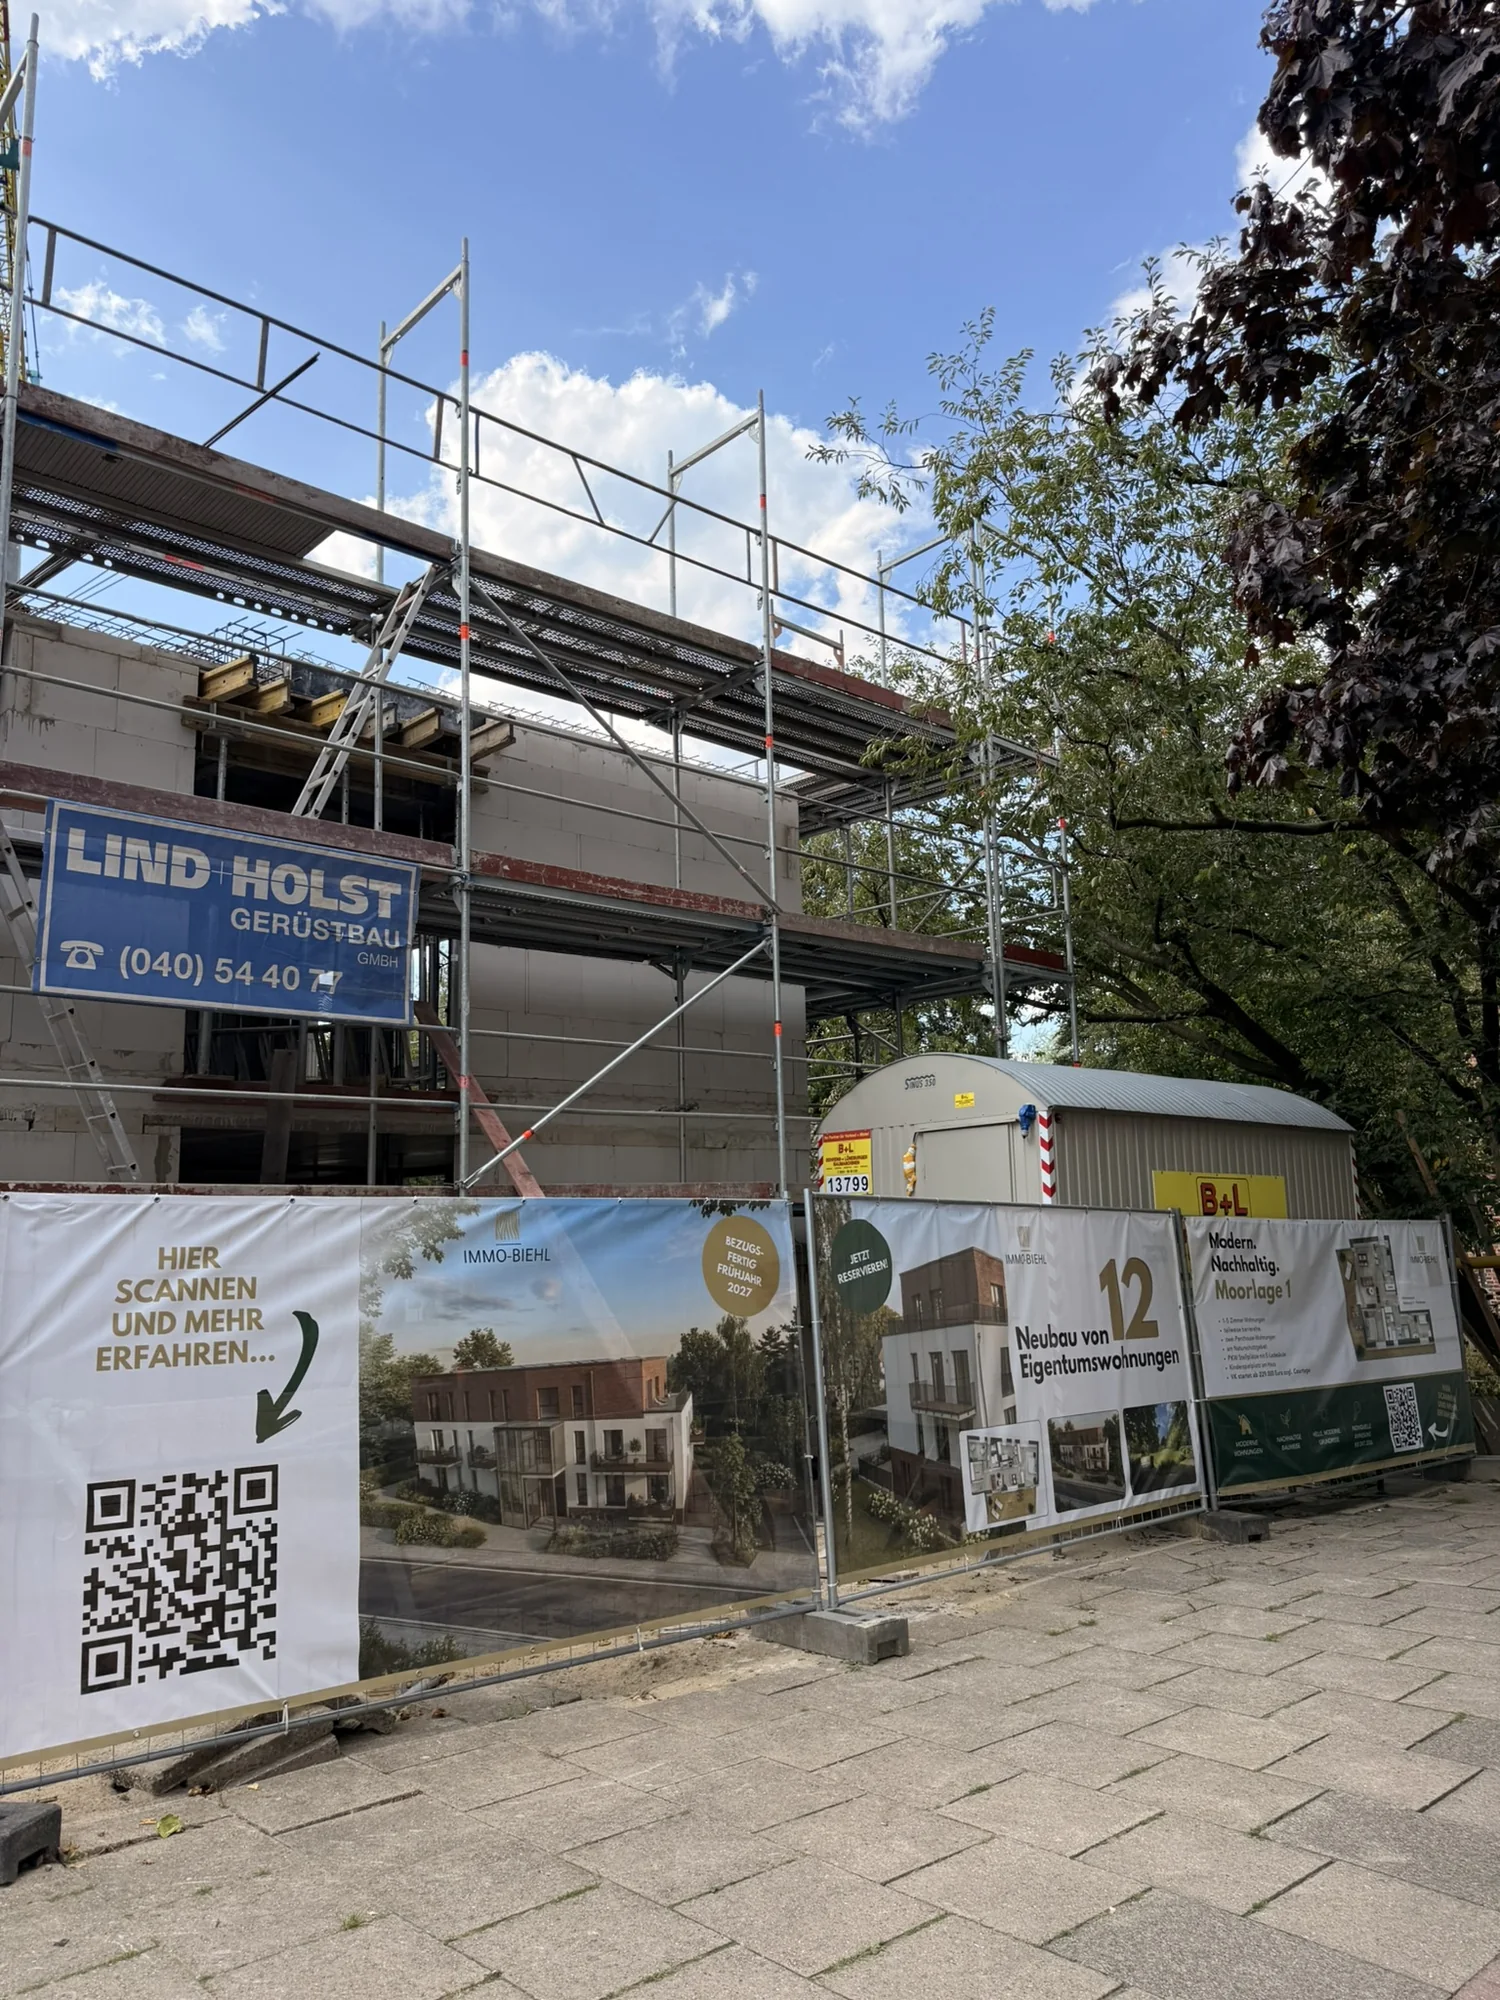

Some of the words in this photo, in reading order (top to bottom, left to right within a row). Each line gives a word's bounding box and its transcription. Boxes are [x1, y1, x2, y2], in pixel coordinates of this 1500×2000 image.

[231, 908, 400, 949] GERÜSTBAU
[120, 946, 203, 986] (040)
[214, 958, 254, 986] 54
[262, 964, 300, 991] 40
[357, 952, 399, 968] GMBH
[838, 1143, 854, 1154] B+L
[828, 1175, 869, 1193] 13799
[1200, 1182, 1248, 1216] B+L
[725, 1236, 764, 1256] BEZUGS-
[1208, 1231, 1257, 1249] Modern.
[158, 1246, 221, 1270] HIER
[464, 1248, 551, 1263] IMMO-BIEHL
[727, 1251, 757, 1269] FERTIG
[850, 1249, 870, 1264] JETZT
[1211, 1254, 1280, 1276] Nachhaltig.
[717, 1263, 762, 1287] FRÜHJAHR
[837, 1258, 888, 1284] RESERVIEREN!
[115, 1277, 257, 1304] SCANNEN
[727, 1282, 753, 1297] 2027
[1215, 1278, 1283, 1305] Moorlage
[1285, 1279, 1291, 1298] 1
[1015, 1324, 1077, 1350] Neubau
[1081, 1329, 1109, 1345] von
[1099, 1257, 1159, 1341] 12
[112, 1310, 177, 1336] UND
[184, 1308, 264, 1334] MEHR
[96, 1340, 275, 1372] ERFAHREN...
[1019, 1345, 1180, 1384] Eigentumswohnungen
